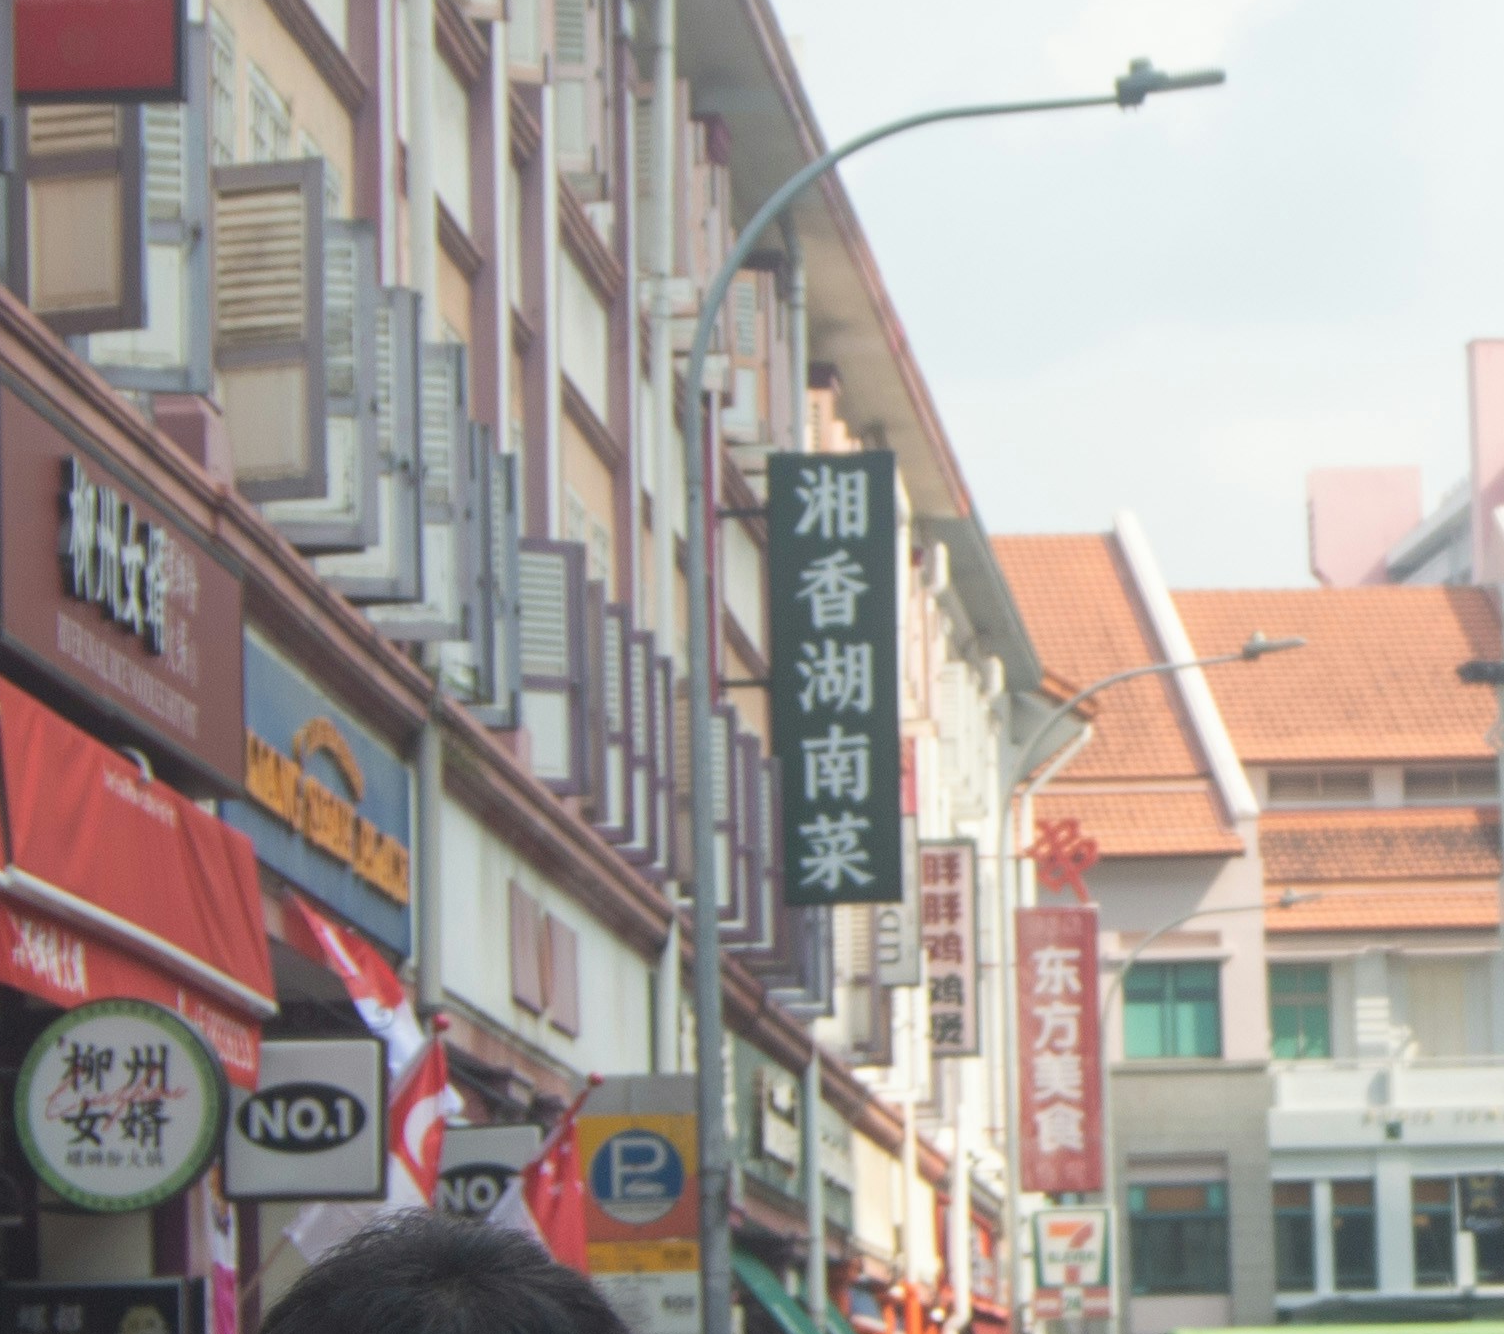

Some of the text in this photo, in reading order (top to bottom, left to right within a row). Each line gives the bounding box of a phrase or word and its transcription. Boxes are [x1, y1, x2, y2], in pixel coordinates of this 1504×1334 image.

[794, 465, 876, 893] 湘香湖南菜
[61, 1041, 169, 1094] 柳州
[1031, 945, 1085, 1154] 东方美食
[59, 1096, 171, 1148] 女婿
[248, 1096, 355, 1141] NO.1
